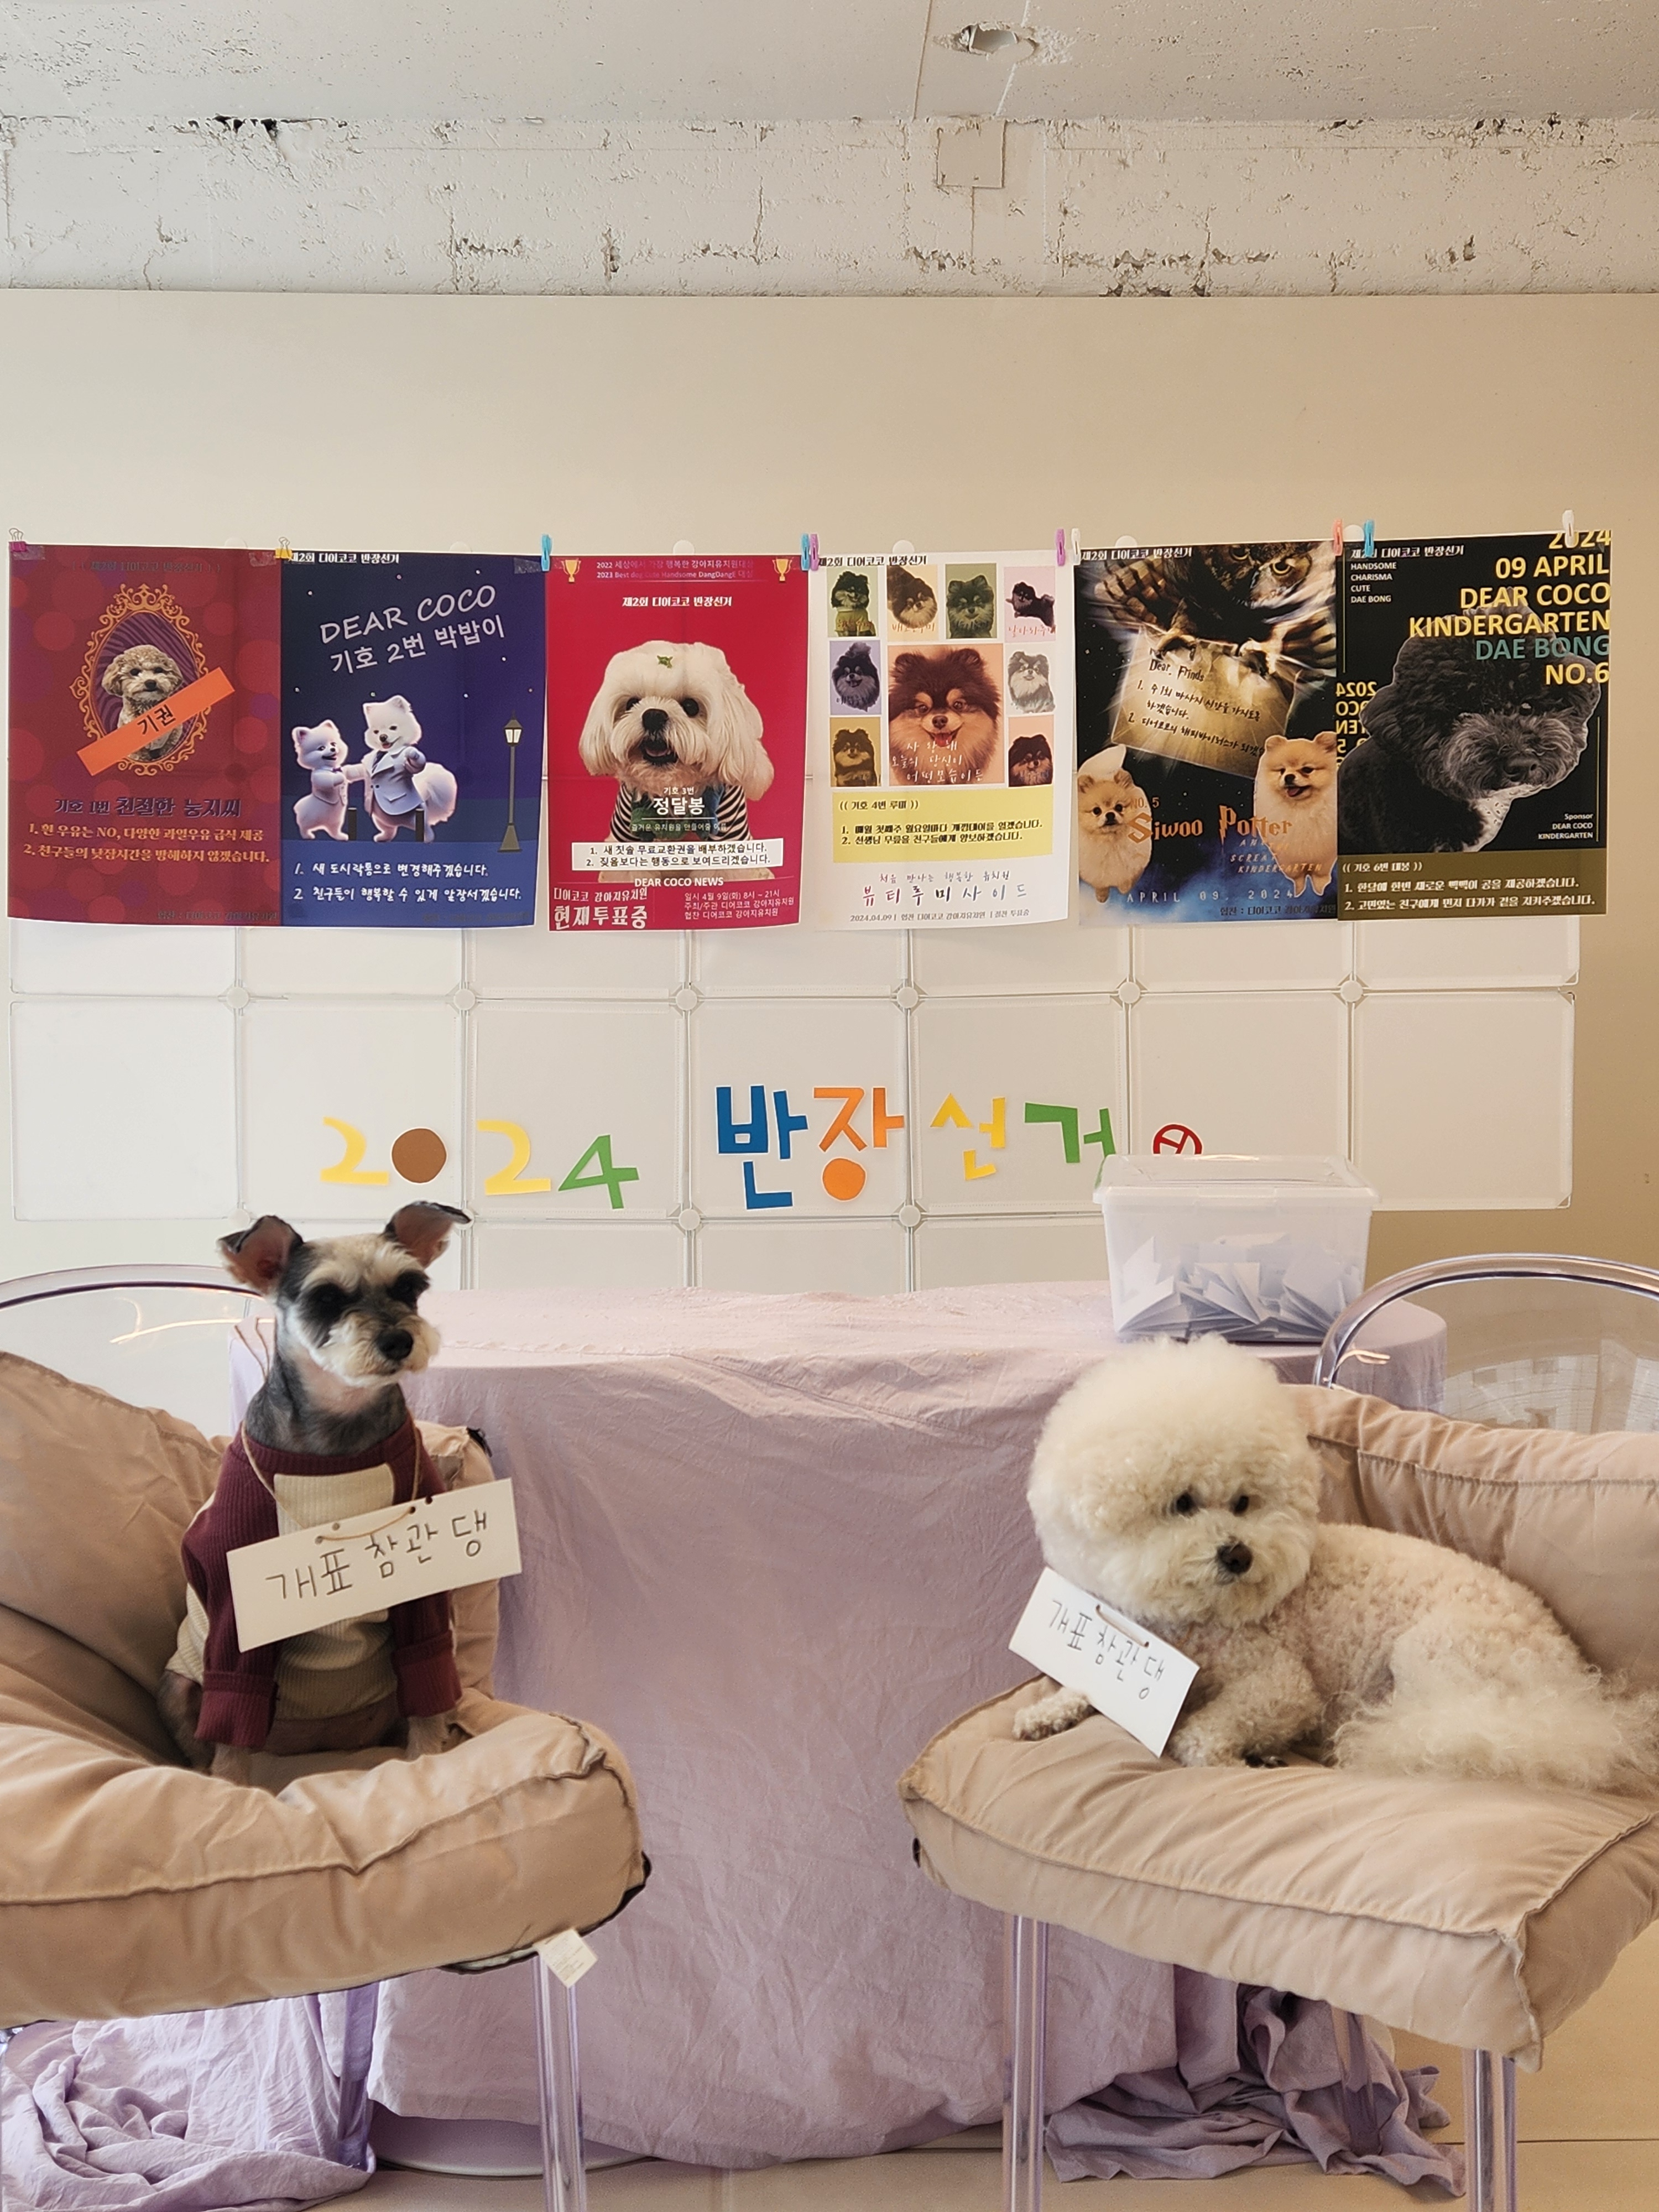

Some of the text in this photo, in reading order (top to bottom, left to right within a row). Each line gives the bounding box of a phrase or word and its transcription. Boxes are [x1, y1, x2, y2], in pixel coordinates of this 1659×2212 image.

[1081, 550, 1108, 561] 제2회
[1424, 545, 1465, 557] 반장선거
[361, 554, 400, 565] 반장선거
[818, 556, 843, 567] 제2회
[889, 555, 927, 566] 반장선거
[1350, 562, 1397, 570] HANDSOME
[1495, 554, 1610, 579] 09 APRIL
[1350, 573, 1393, 581] CHARISMA
[1350, 584, 1371, 592] CUTE
[1460, 582, 1611, 608] DEAR COCO
[622, 597, 649, 607] 제2회
[693, 596, 732, 607] 반장선거
[320, 585, 495, 644] DEAR COCO
[1410, 609, 1611, 638] KINDERGARTEN
[330, 614, 505, 674] 기호 2번 박밥이
[1475, 635, 1610, 660] DAE BONG
[1545, 662, 1610, 686] NO.6
[1137, 679, 1144, 690] 1.
[1176, 691, 1204, 705] 마사지
[1205, 699, 1229, 714] 시간을
[137, 704, 176, 737] 기권
[892, 754, 962, 769] 오늘의 당신이
[664, 786, 695, 795] 기호 3번
[54, 799, 84, 814] 기호
[88, 800, 111, 816] 1번
[114, 796, 176, 818] 친절한
[653, 796, 705, 816] 정달봉
[851, 801, 868, 810] 기호
[871, 801, 886, 810] 4번
[1152, 796, 1160, 808] 5
[29, 823, 39, 834] 1.
[56, 825, 93, 838] 우유는
[96, 827, 121, 841] NO,
[124, 827, 160, 841] 다양한
[163, 827, 211, 841] 과일우유
[213, 829, 237, 842] 급식
[239, 830, 264, 842] 제공
[842, 826, 849, 834] 1.
[1127, 805, 1292, 846] Siwoo Potter
[841, 836, 851, 845] 2.
[855, 836, 881, 845] 선생님
[23, 843, 270, 863] 2. 친구들의 방해하지 않겠습니다.
[603, 845, 613, 855] 새
[615, 845, 635, 855] 칫솔
[637, 844, 696, 855] 무료교환권을
[698, 842, 767, 854] 배부하겠습니다.
[651, 856, 690, 867] 행동으로
[692, 854, 770, 867] 보여드리겠습니다.
[1353, 863, 1371, 873] 기호
[1373, 862, 1389, 872] 6번
[294, 863, 305, 874] 1.
[312, 863, 325, 875] 새
[331, 862, 392, 877] 도시락통으로
[634, 877, 724, 888] DEAR COCO NEWS
[880, 873, 897, 884] 처음
[906, 873, 934, 883] 만나는
[945, 871, 973, 883] 행복한
[1344, 877, 1579, 893] 1. 한달에 한번 새로운 공을 제공하겠습니다.
[313, 886, 354, 901] 친구들이
[361, 887, 394, 902] 행복할
[398, 887, 408, 902] 수
[415, 889, 439, 902] 있게
[594, 886, 648, 902] 강아지유치원
[685, 893, 700, 901] 일시
[743, 890, 755, 900] 8시
[764, 889, 780, 898] 21시
[1126, 889, 1293, 903] APRIL 2024
[753, 896, 795, 909] 강아지유치원
[1344, 901, 1355, 911] 2.
[1399, 898, 1439, 910] 친구에게
[1466, 896, 1495, 908] 다가가
[554, 905, 648, 930] 현재투표중
[735, 907, 779, 919] 강아지유치원
[715, 1085, 1116, 1210] 반장선거
